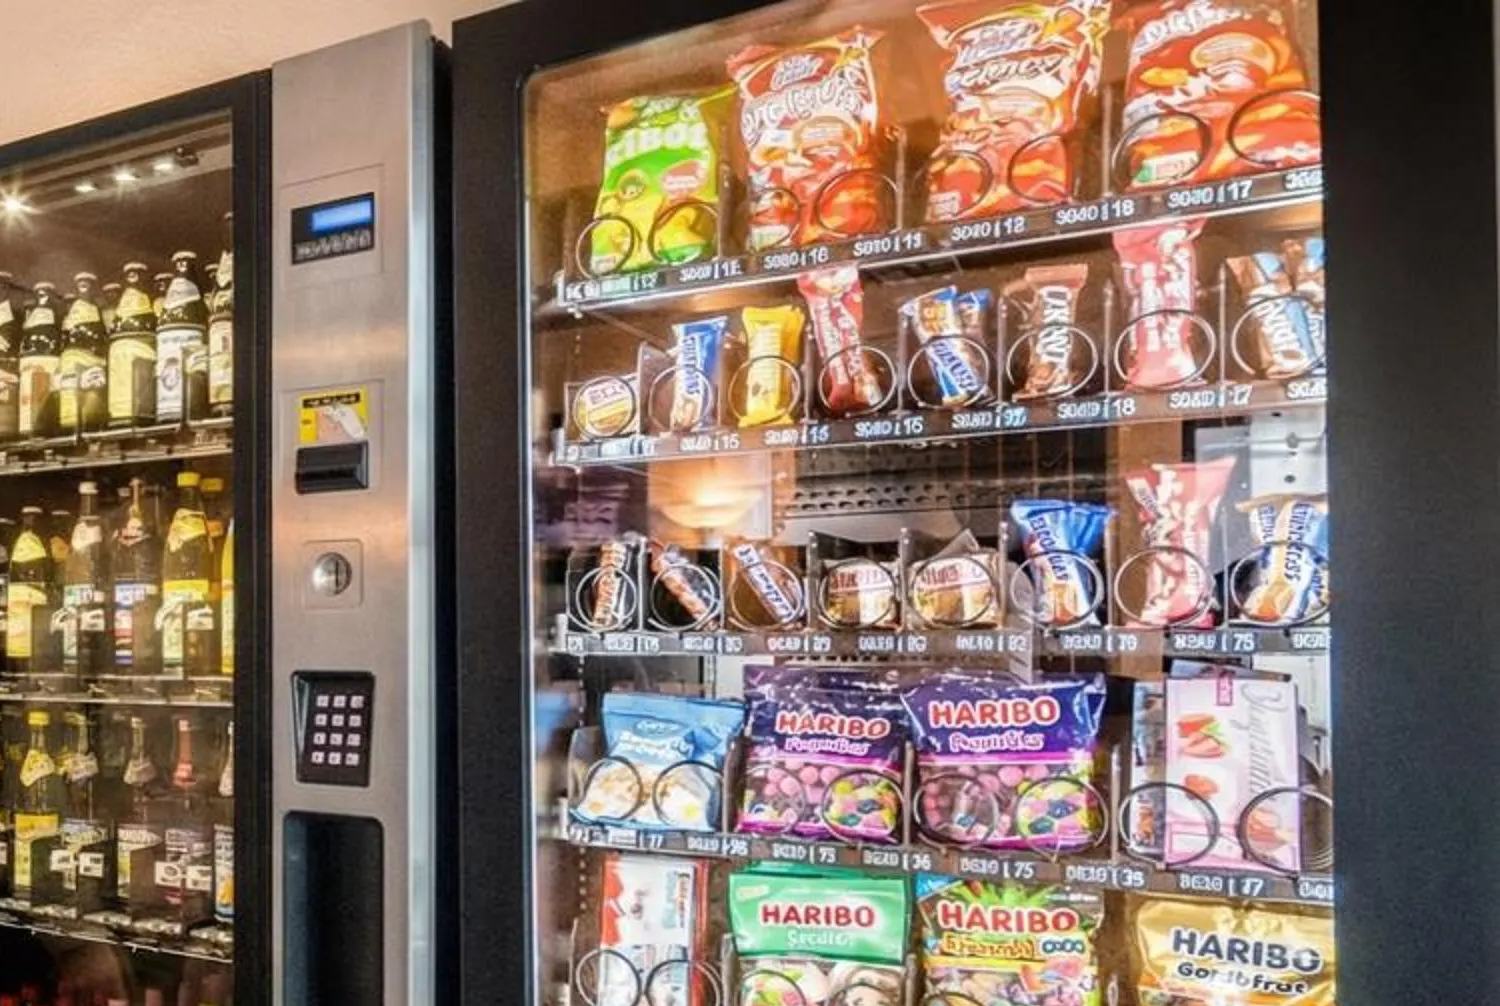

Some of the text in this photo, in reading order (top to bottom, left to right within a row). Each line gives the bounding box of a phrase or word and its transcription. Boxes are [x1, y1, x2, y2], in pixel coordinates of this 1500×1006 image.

[776, 710, 890, 738] HARIBO
[930, 697, 1069, 728] HARIBO
[761, 903, 876, 927] HARIBO
[939, 901, 1078, 934] HARIBO
